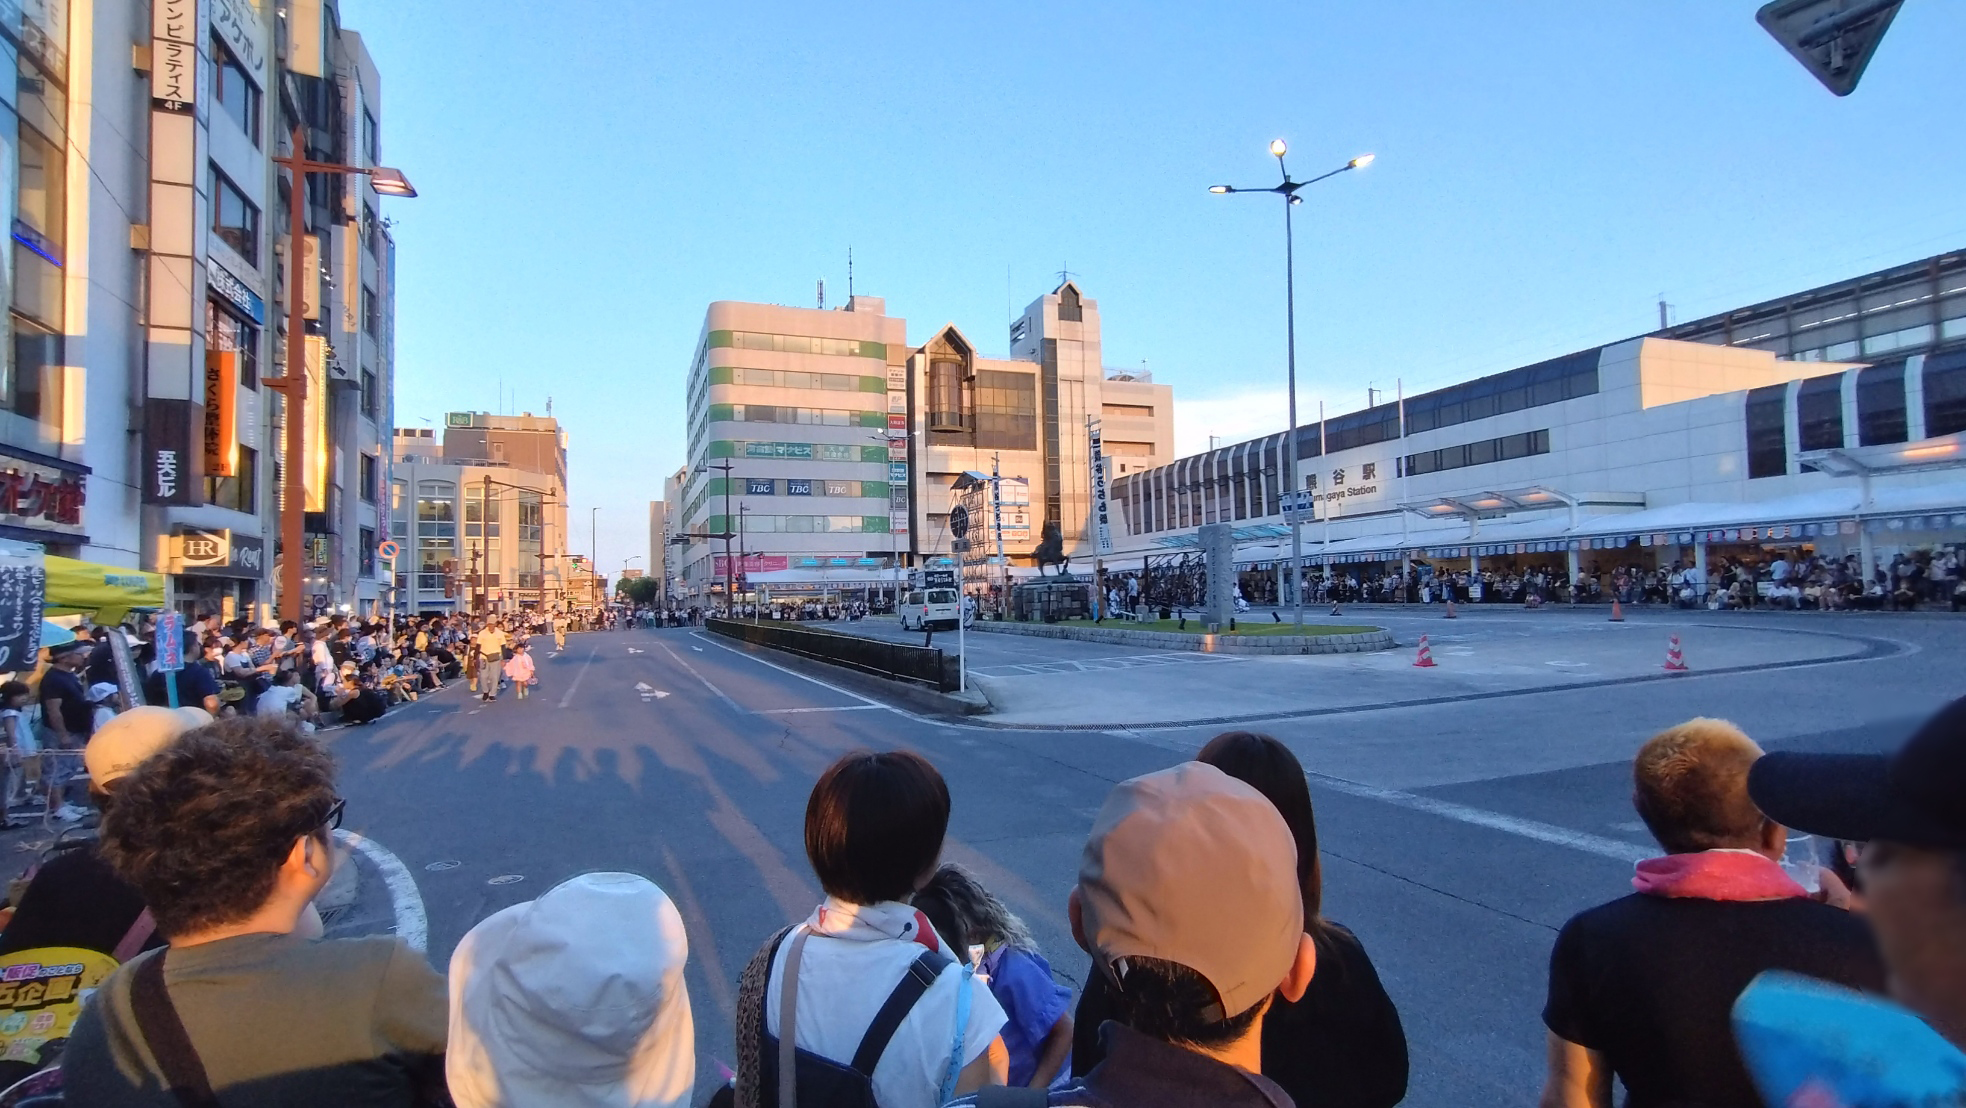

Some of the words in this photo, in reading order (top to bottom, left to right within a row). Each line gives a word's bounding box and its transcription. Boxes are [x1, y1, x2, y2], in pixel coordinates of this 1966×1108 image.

[166, 0, 184, 98] ンピラティス
[164, 101, 182, 111] 4F
[1305, 462, 1377, 490] 熊谷駅
[751, 484, 771, 493] TBC
[790, 485, 809, 494] TBC
[828, 486, 847, 495] TBC
[1347, 485, 1377, 497] Station
[187, 540, 216, 556] HR
